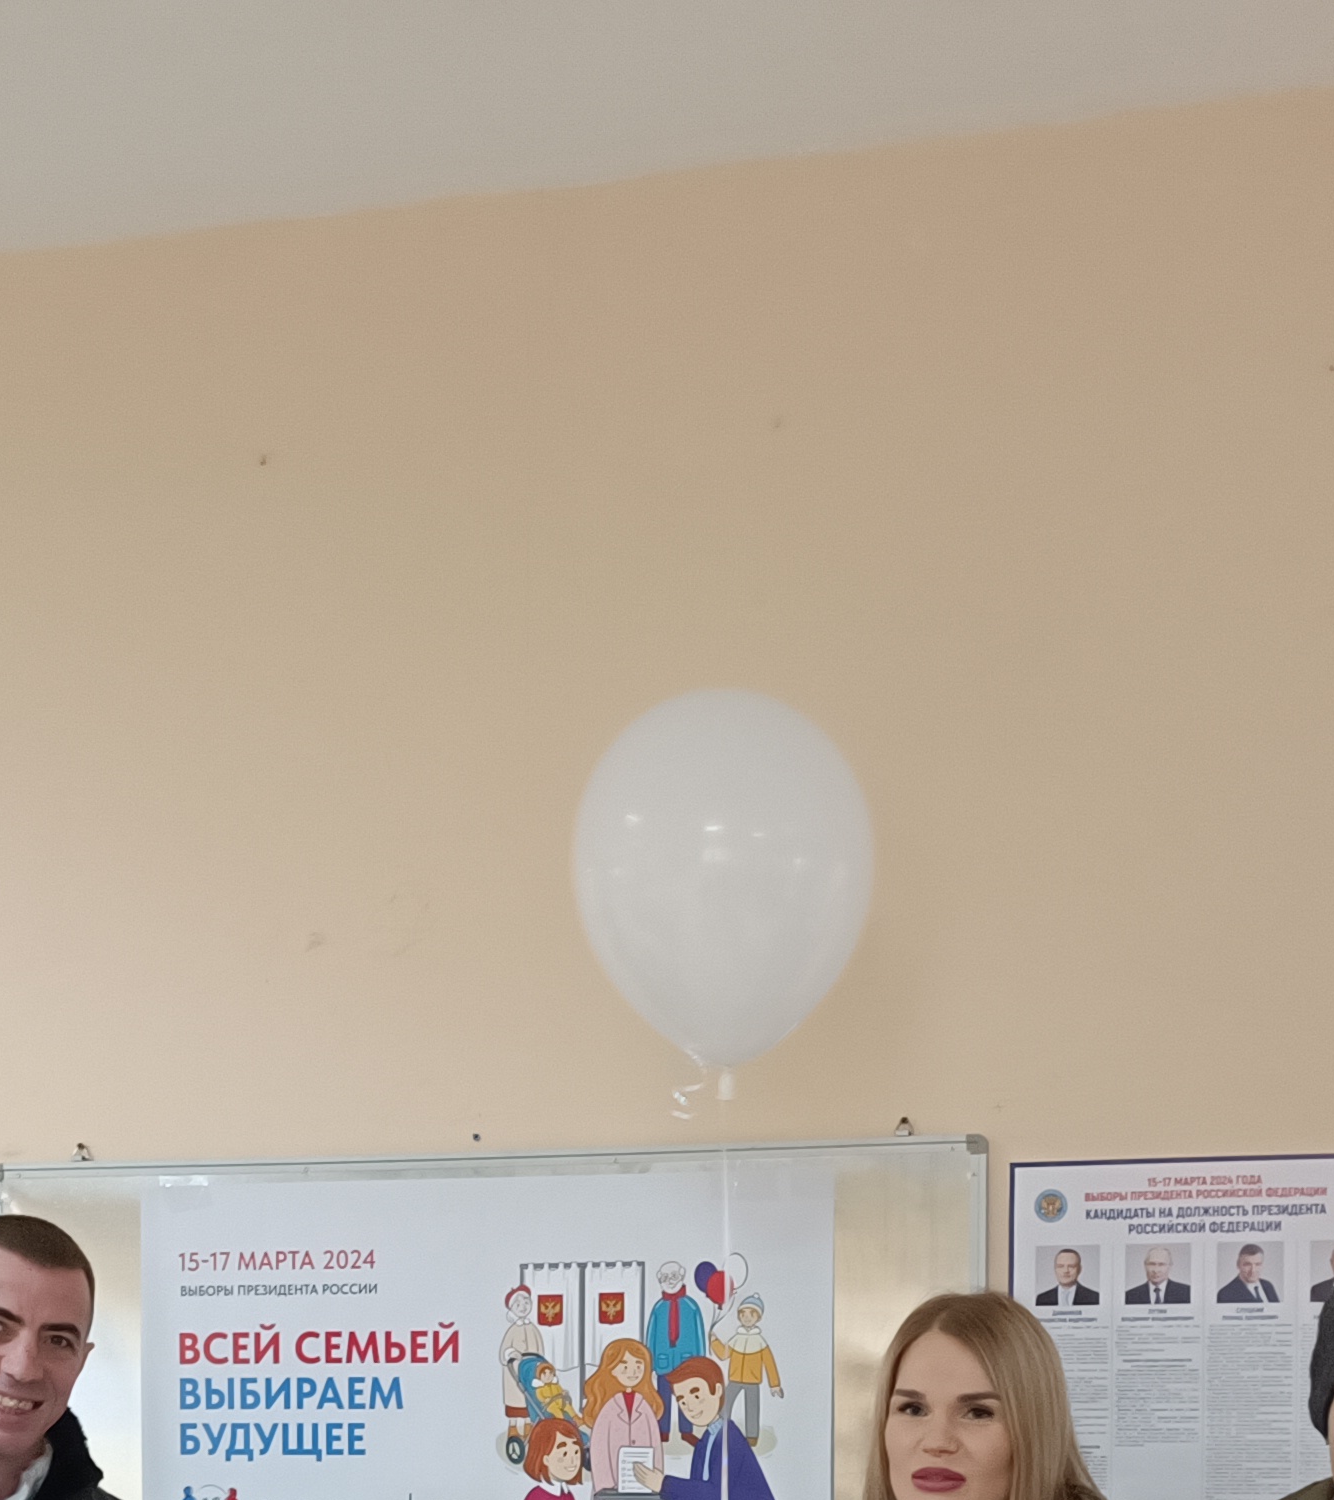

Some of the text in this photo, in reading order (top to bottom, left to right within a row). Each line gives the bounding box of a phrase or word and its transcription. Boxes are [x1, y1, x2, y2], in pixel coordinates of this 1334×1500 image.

[1174, 1176, 1208, 1187] МАРТА
[1236, 1175, 1262, 1186] ГОДА
[1084, 1186, 1328, 1202] ВЫБОРЫ ПРЕЗИДЕНТА РОССИЙСКОЙ ФЕДЕРАЦИИ
[1085, 1203, 1327, 1220] КАНДИДАТЫ НА ДОЛЖНОСТЬ ПРЕЗИДЕНТА
[1128, 1220, 1282, 1235] РОССИЙСКОЙ ФЕДЕРАЦИИ
[178, 1249, 376, 1272] 15-17 МАРТА 2024
[180, 1283, 378, 1298] ВЫБОРЫ ПРЕЗИДЕНТА РОССИИ
[179, 1321, 459, 1365] ВСЕЙ СЕМЬЕЙ
[179, 1376, 404, 1410] ВЫБИРАЕМ
[179, 1422, 366, 1462] БУДУЩЕЕ
